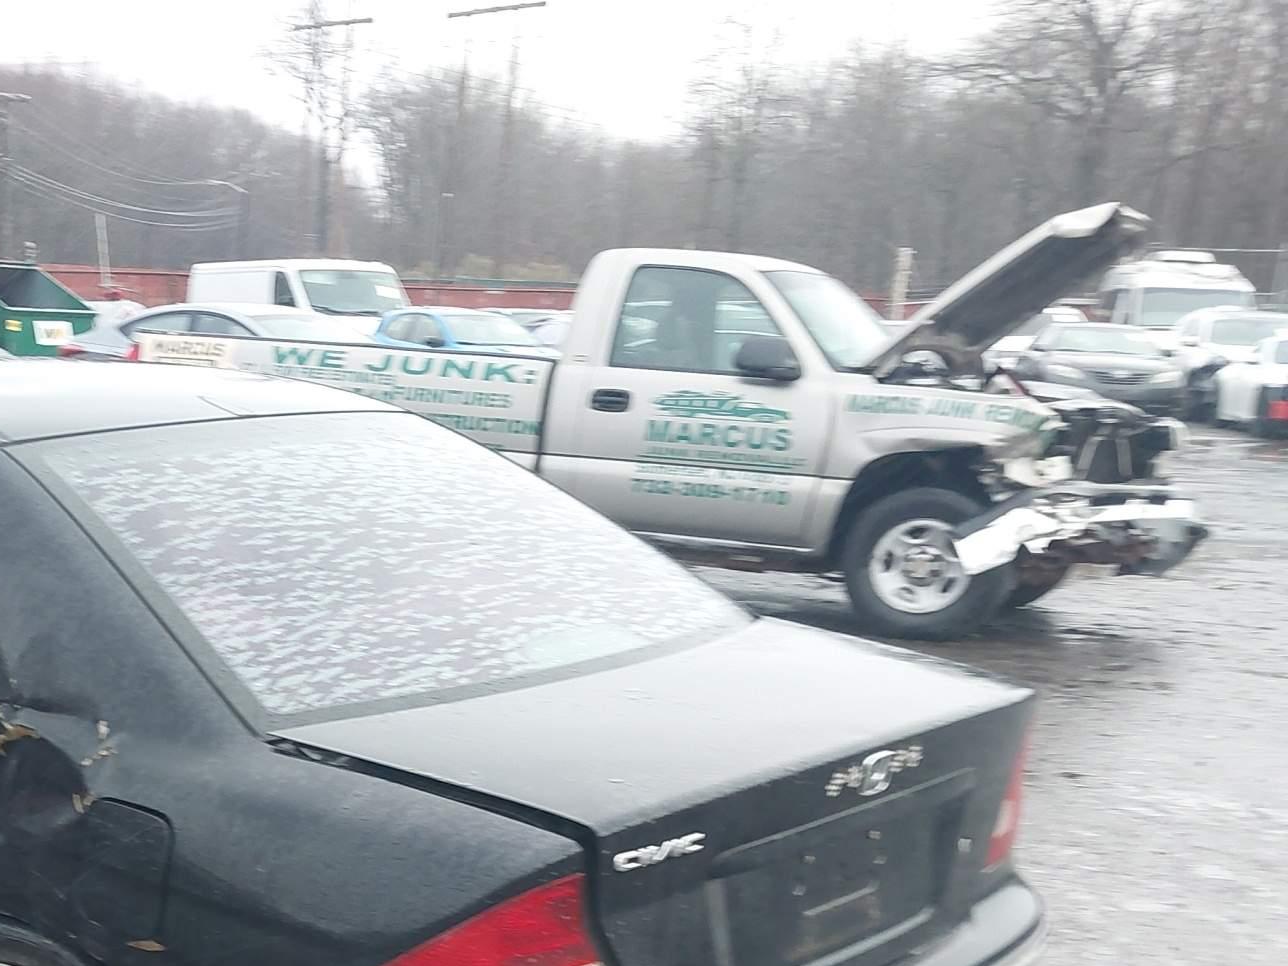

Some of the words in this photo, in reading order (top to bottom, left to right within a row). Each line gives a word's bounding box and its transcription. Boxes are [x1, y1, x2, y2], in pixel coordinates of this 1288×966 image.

[272, 345, 347, 368] WE
[367, 353, 536, 385] JUNK:
[646, 419, 792, 452] MARCUS
